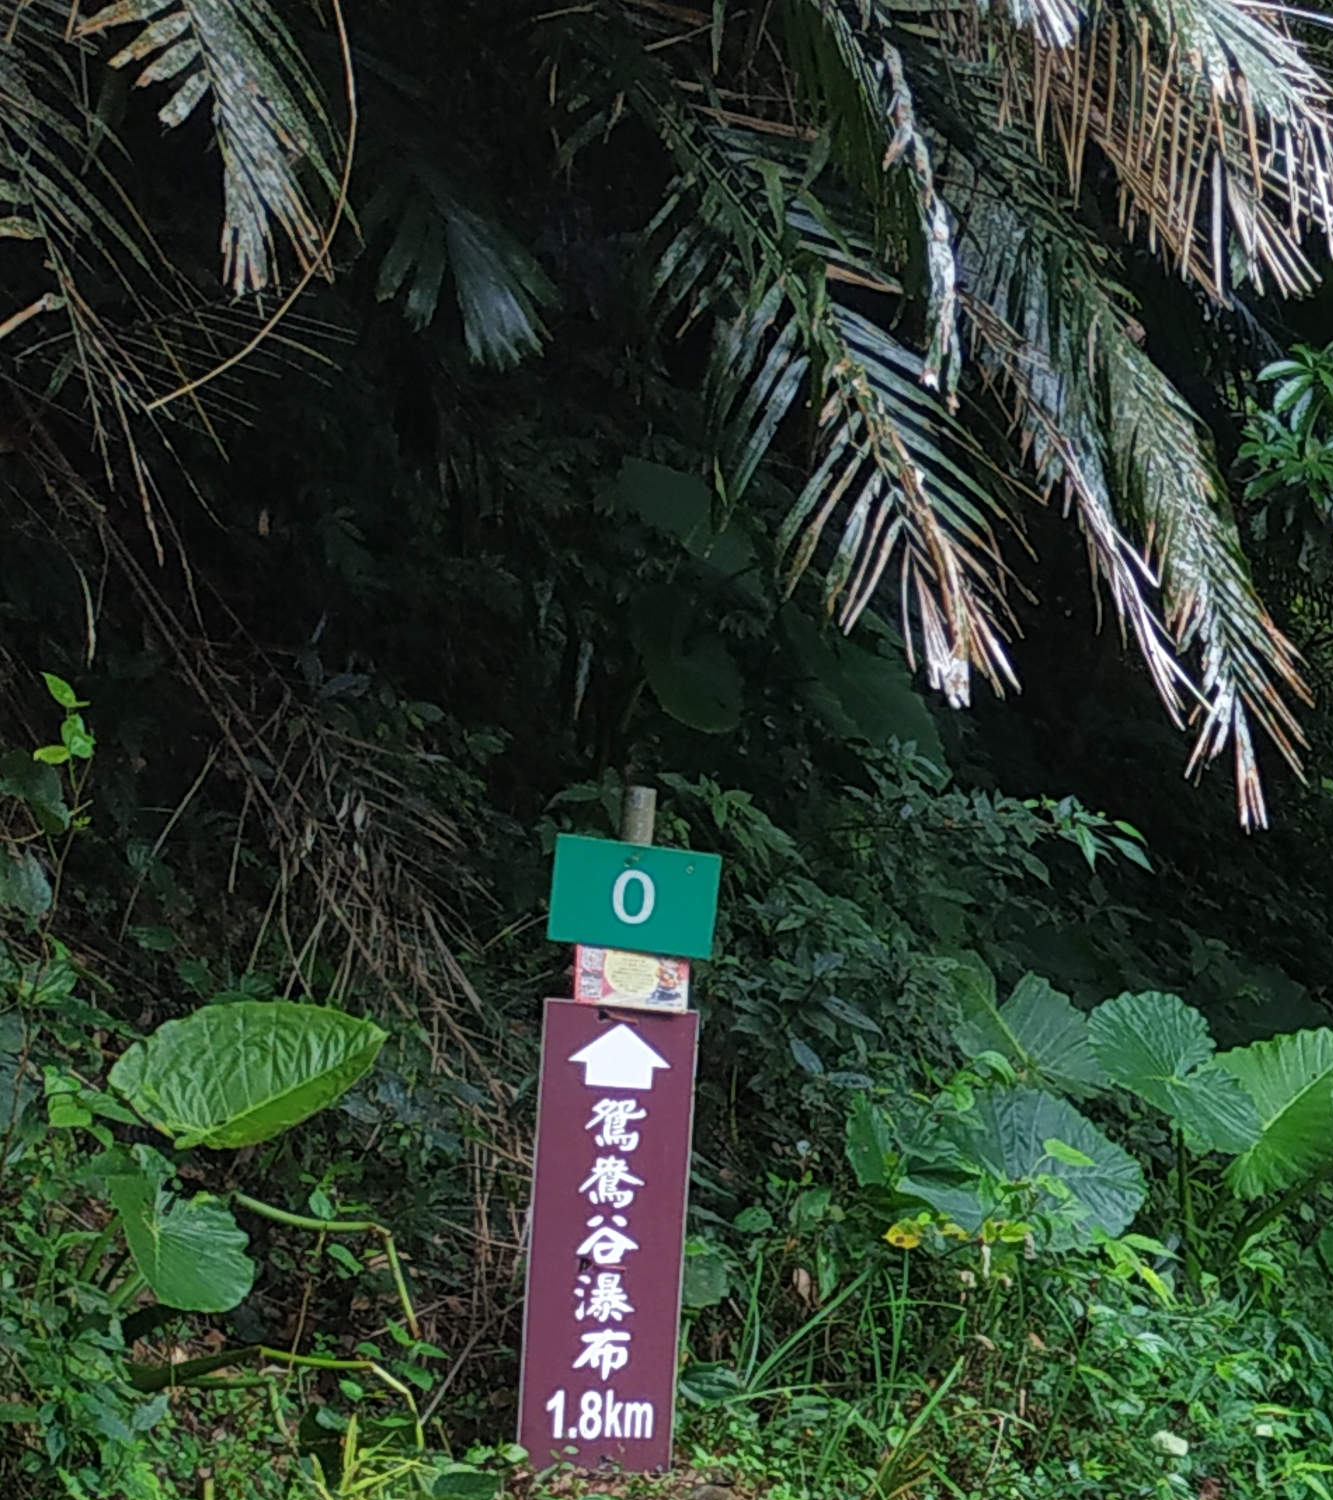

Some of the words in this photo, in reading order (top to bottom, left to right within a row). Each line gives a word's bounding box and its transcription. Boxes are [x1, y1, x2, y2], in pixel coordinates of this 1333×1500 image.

[612, 869, 656, 924] 0
[572, 1098, 648, 1382] 鴛鴦谷瀑布
[545, 1388, 655, 1440] 1.8km
